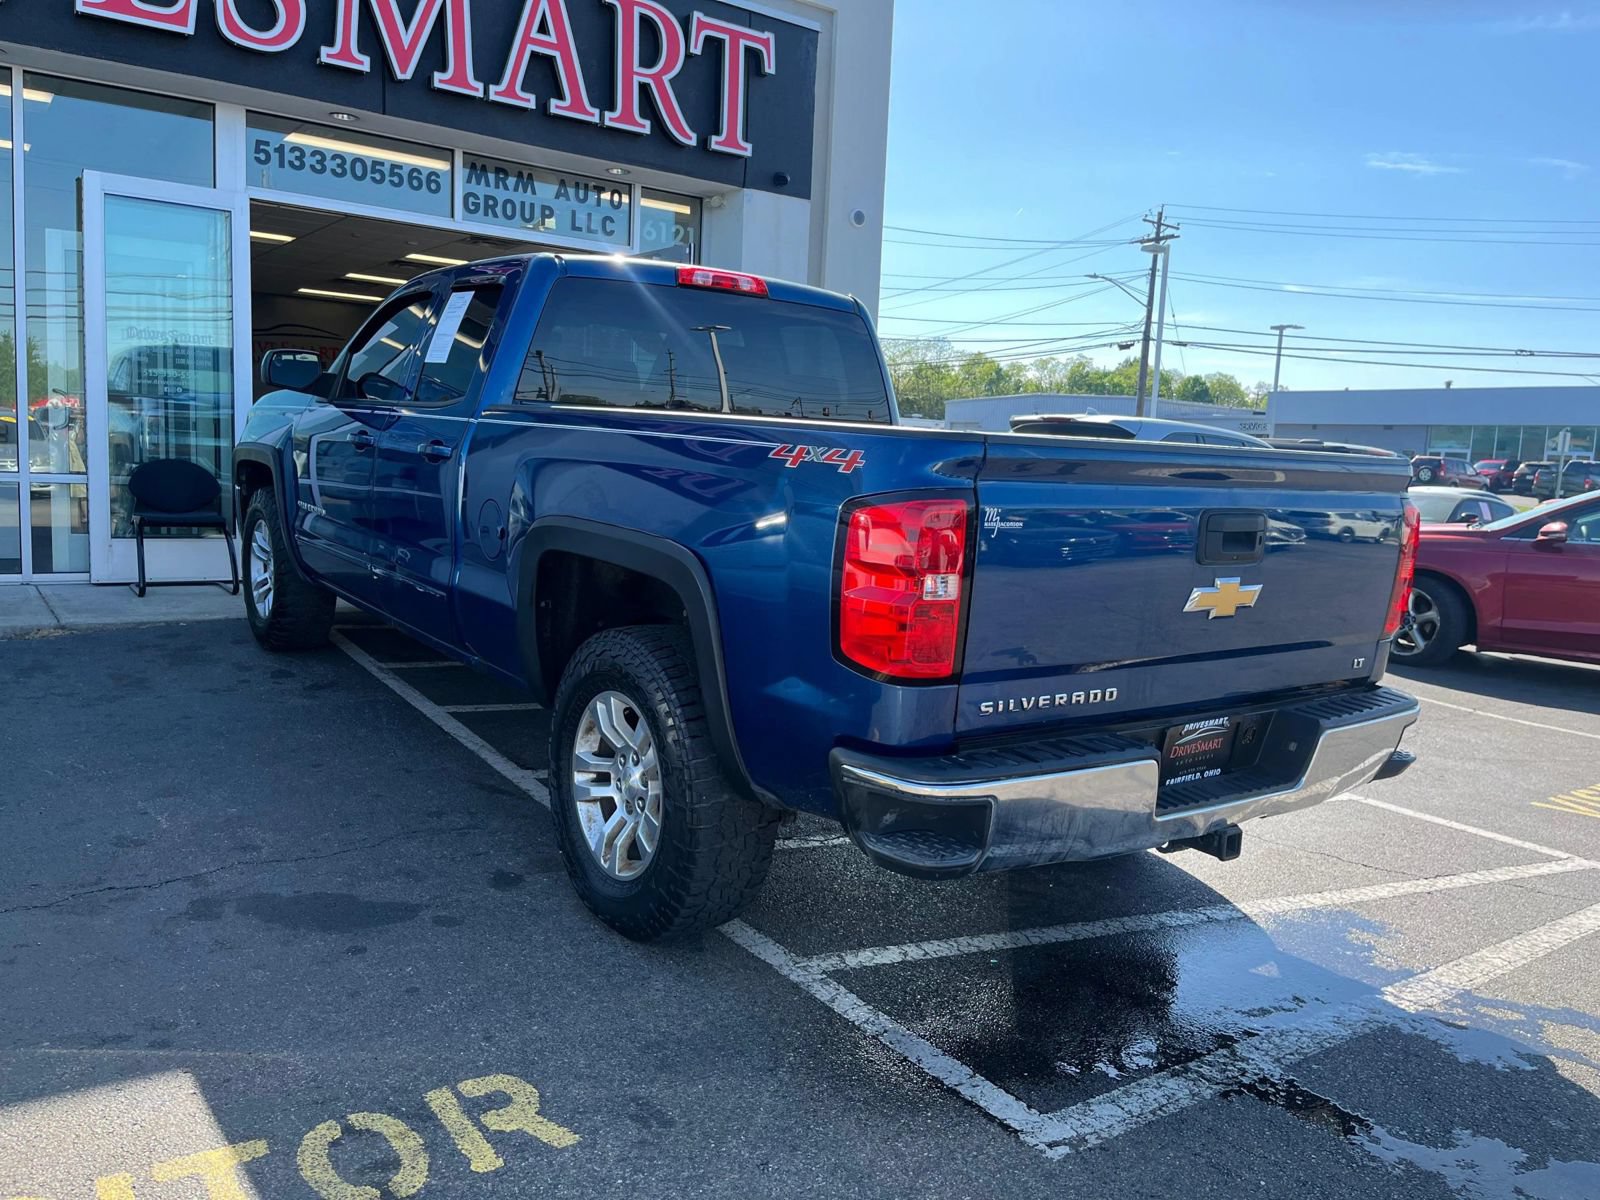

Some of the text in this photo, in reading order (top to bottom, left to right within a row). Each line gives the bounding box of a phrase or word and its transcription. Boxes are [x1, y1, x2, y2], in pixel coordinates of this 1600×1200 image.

[74, 0, 776, 158] MART
[253, 140, 442, 195] 5133305566
[466, 162, 623, 210] MRM AUTO
[463, 192, 616, 237] GROUP LLC
[643, 219, 695, 246] 6121
[1353, 657, 1365, 669] LT
[979, 687, 1119, 716] SILVERADO
[1184, 717, 1228, 731] DRIVESMART
[1166, 773, 1202, 785] FAIRFIELD,
[1203, 768, 1221, 778] OHIO
